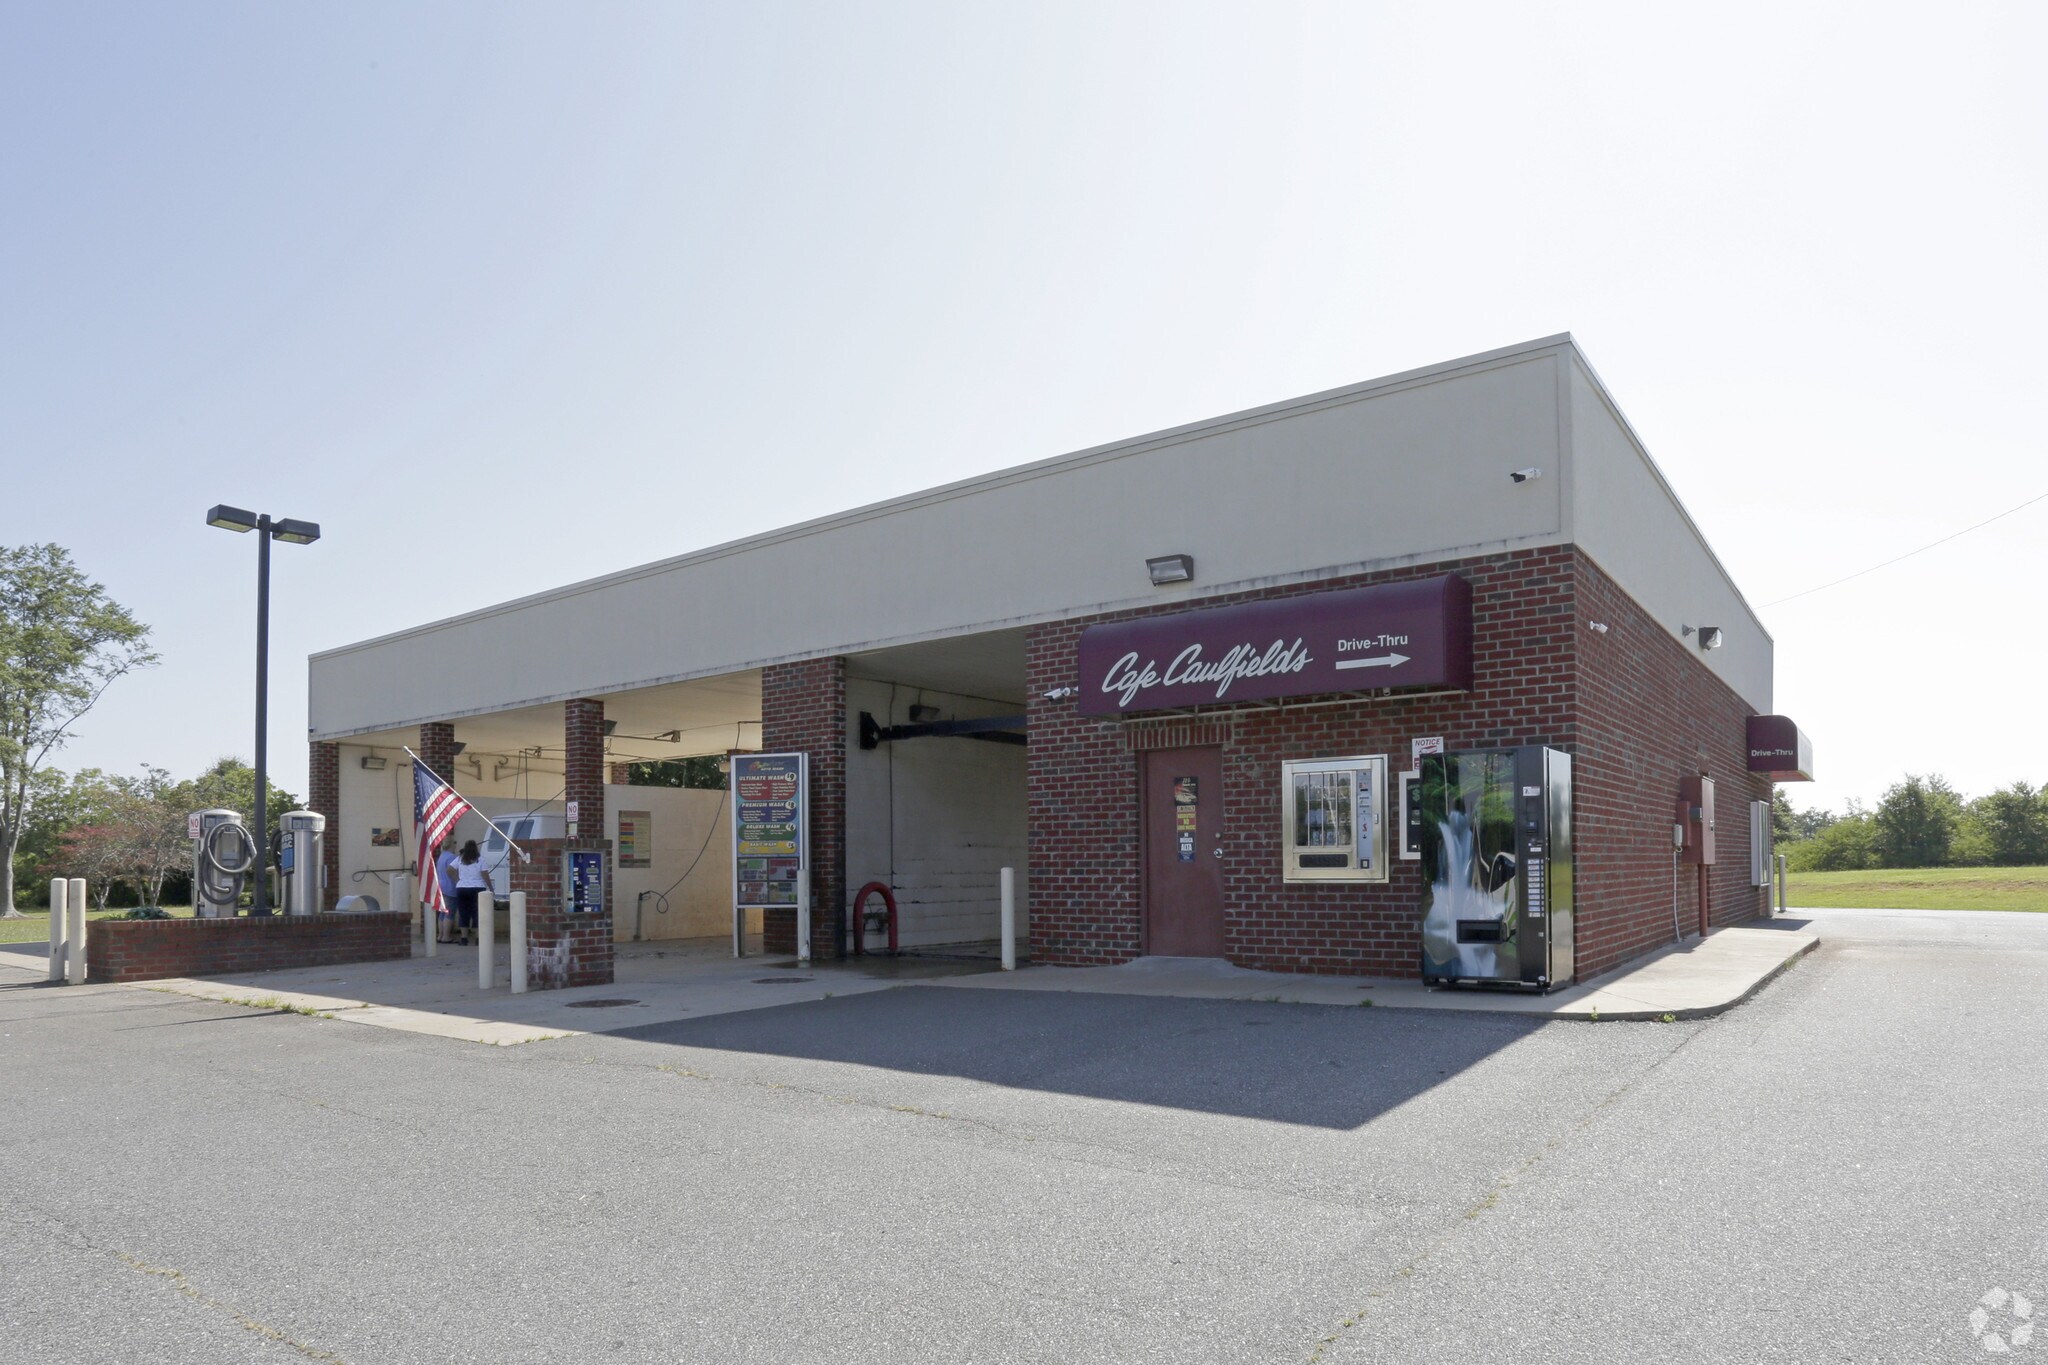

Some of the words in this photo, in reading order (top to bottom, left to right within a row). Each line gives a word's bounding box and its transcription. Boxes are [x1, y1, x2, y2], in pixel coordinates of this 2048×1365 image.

[1337, 634, 1409, 652] Drive-Thru
[1101, 651, 1161, 708] Cafe
[1163, 636, 1314, 698] Caulfields
[1415, 738, 1441, 746] NOTICE
[1751, 749, 1794, 757] Drive-Thru
[568, 805, 577, 813] NO
[190, 818, 199, 828] NO
